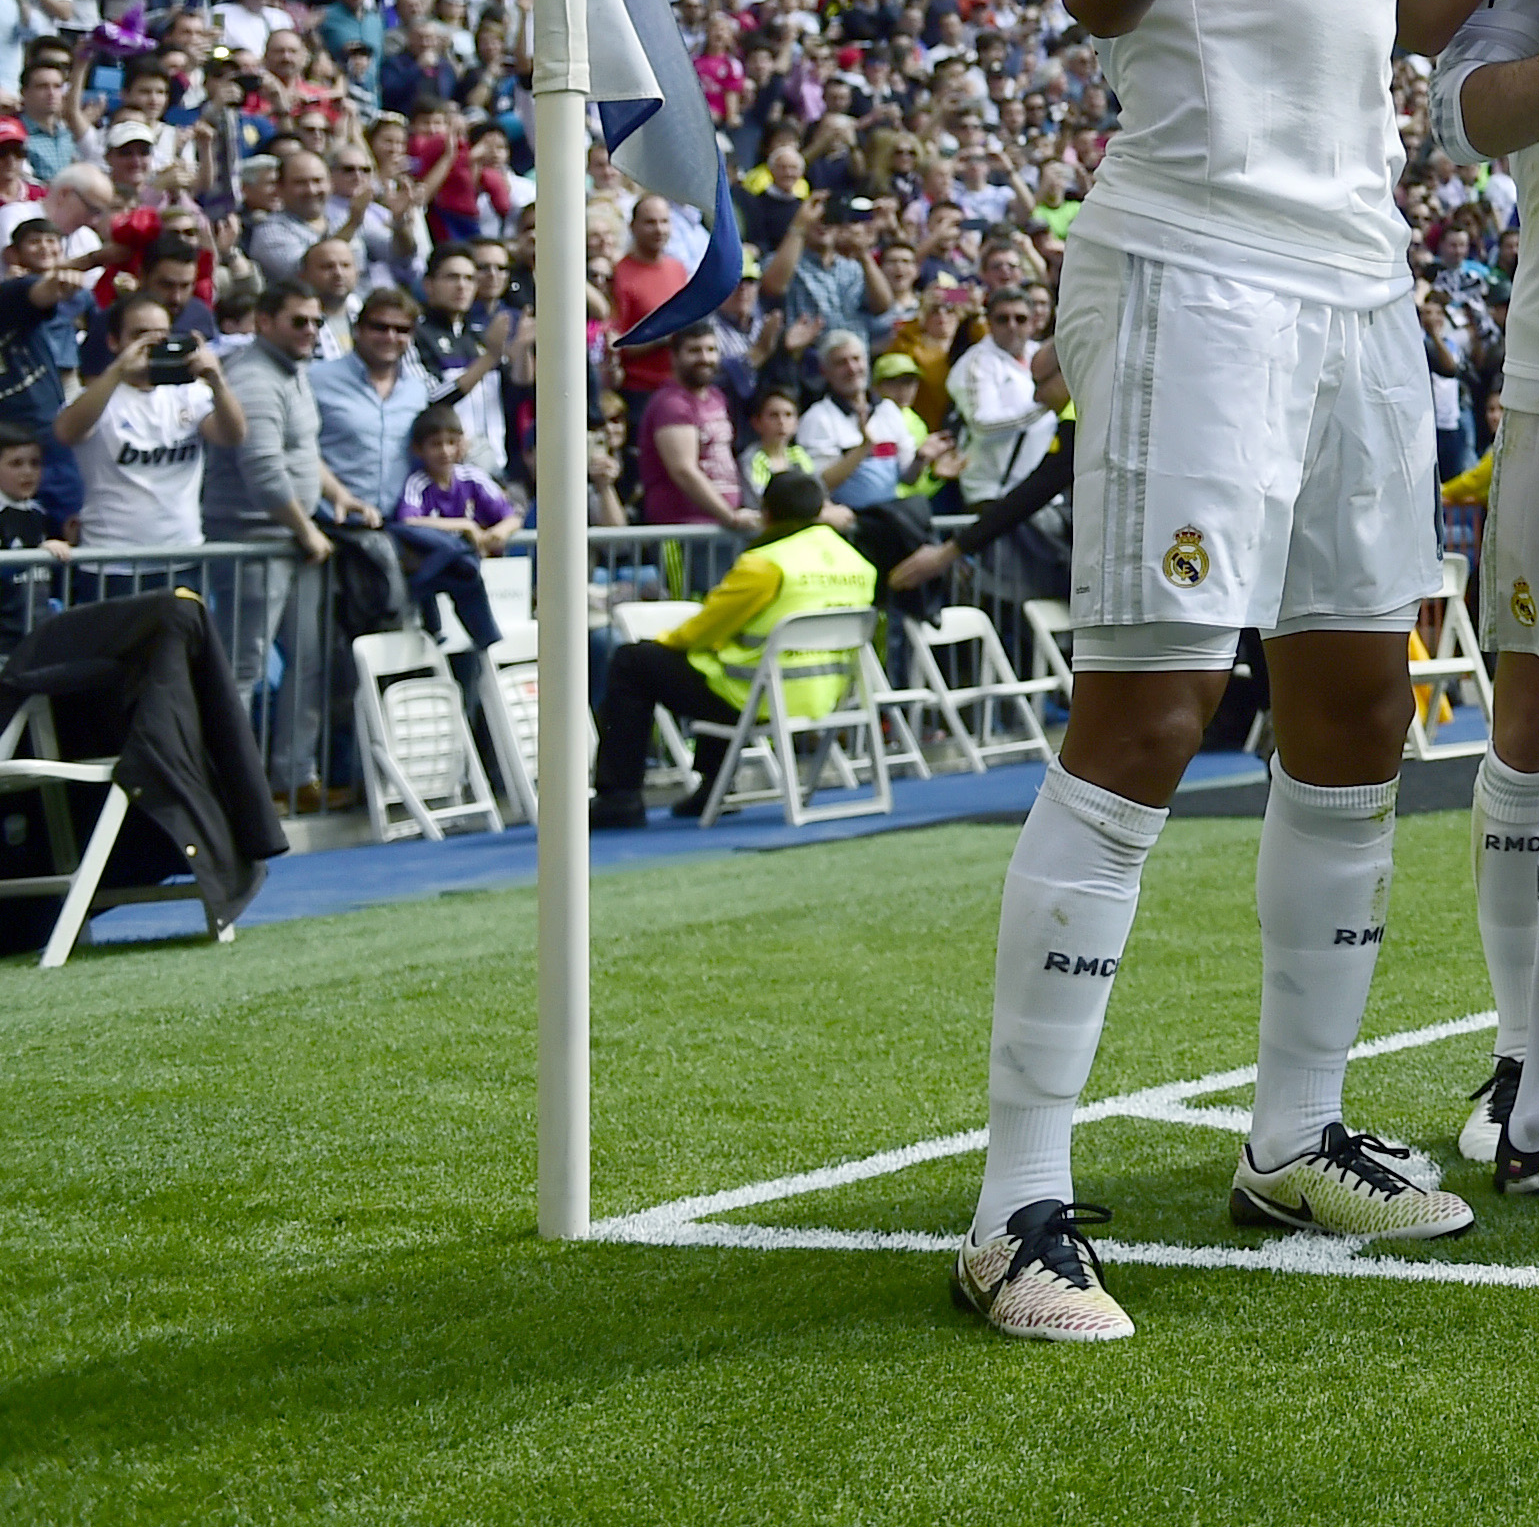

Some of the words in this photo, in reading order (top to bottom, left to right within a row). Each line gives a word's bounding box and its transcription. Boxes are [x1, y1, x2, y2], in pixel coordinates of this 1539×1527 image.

[117, 439, 197, 466] bwin
[799, 573, 867, 586] STEWARD
[1334, 924, 1386, 946] RM
[1044, 951, 1121, 978] RMC
